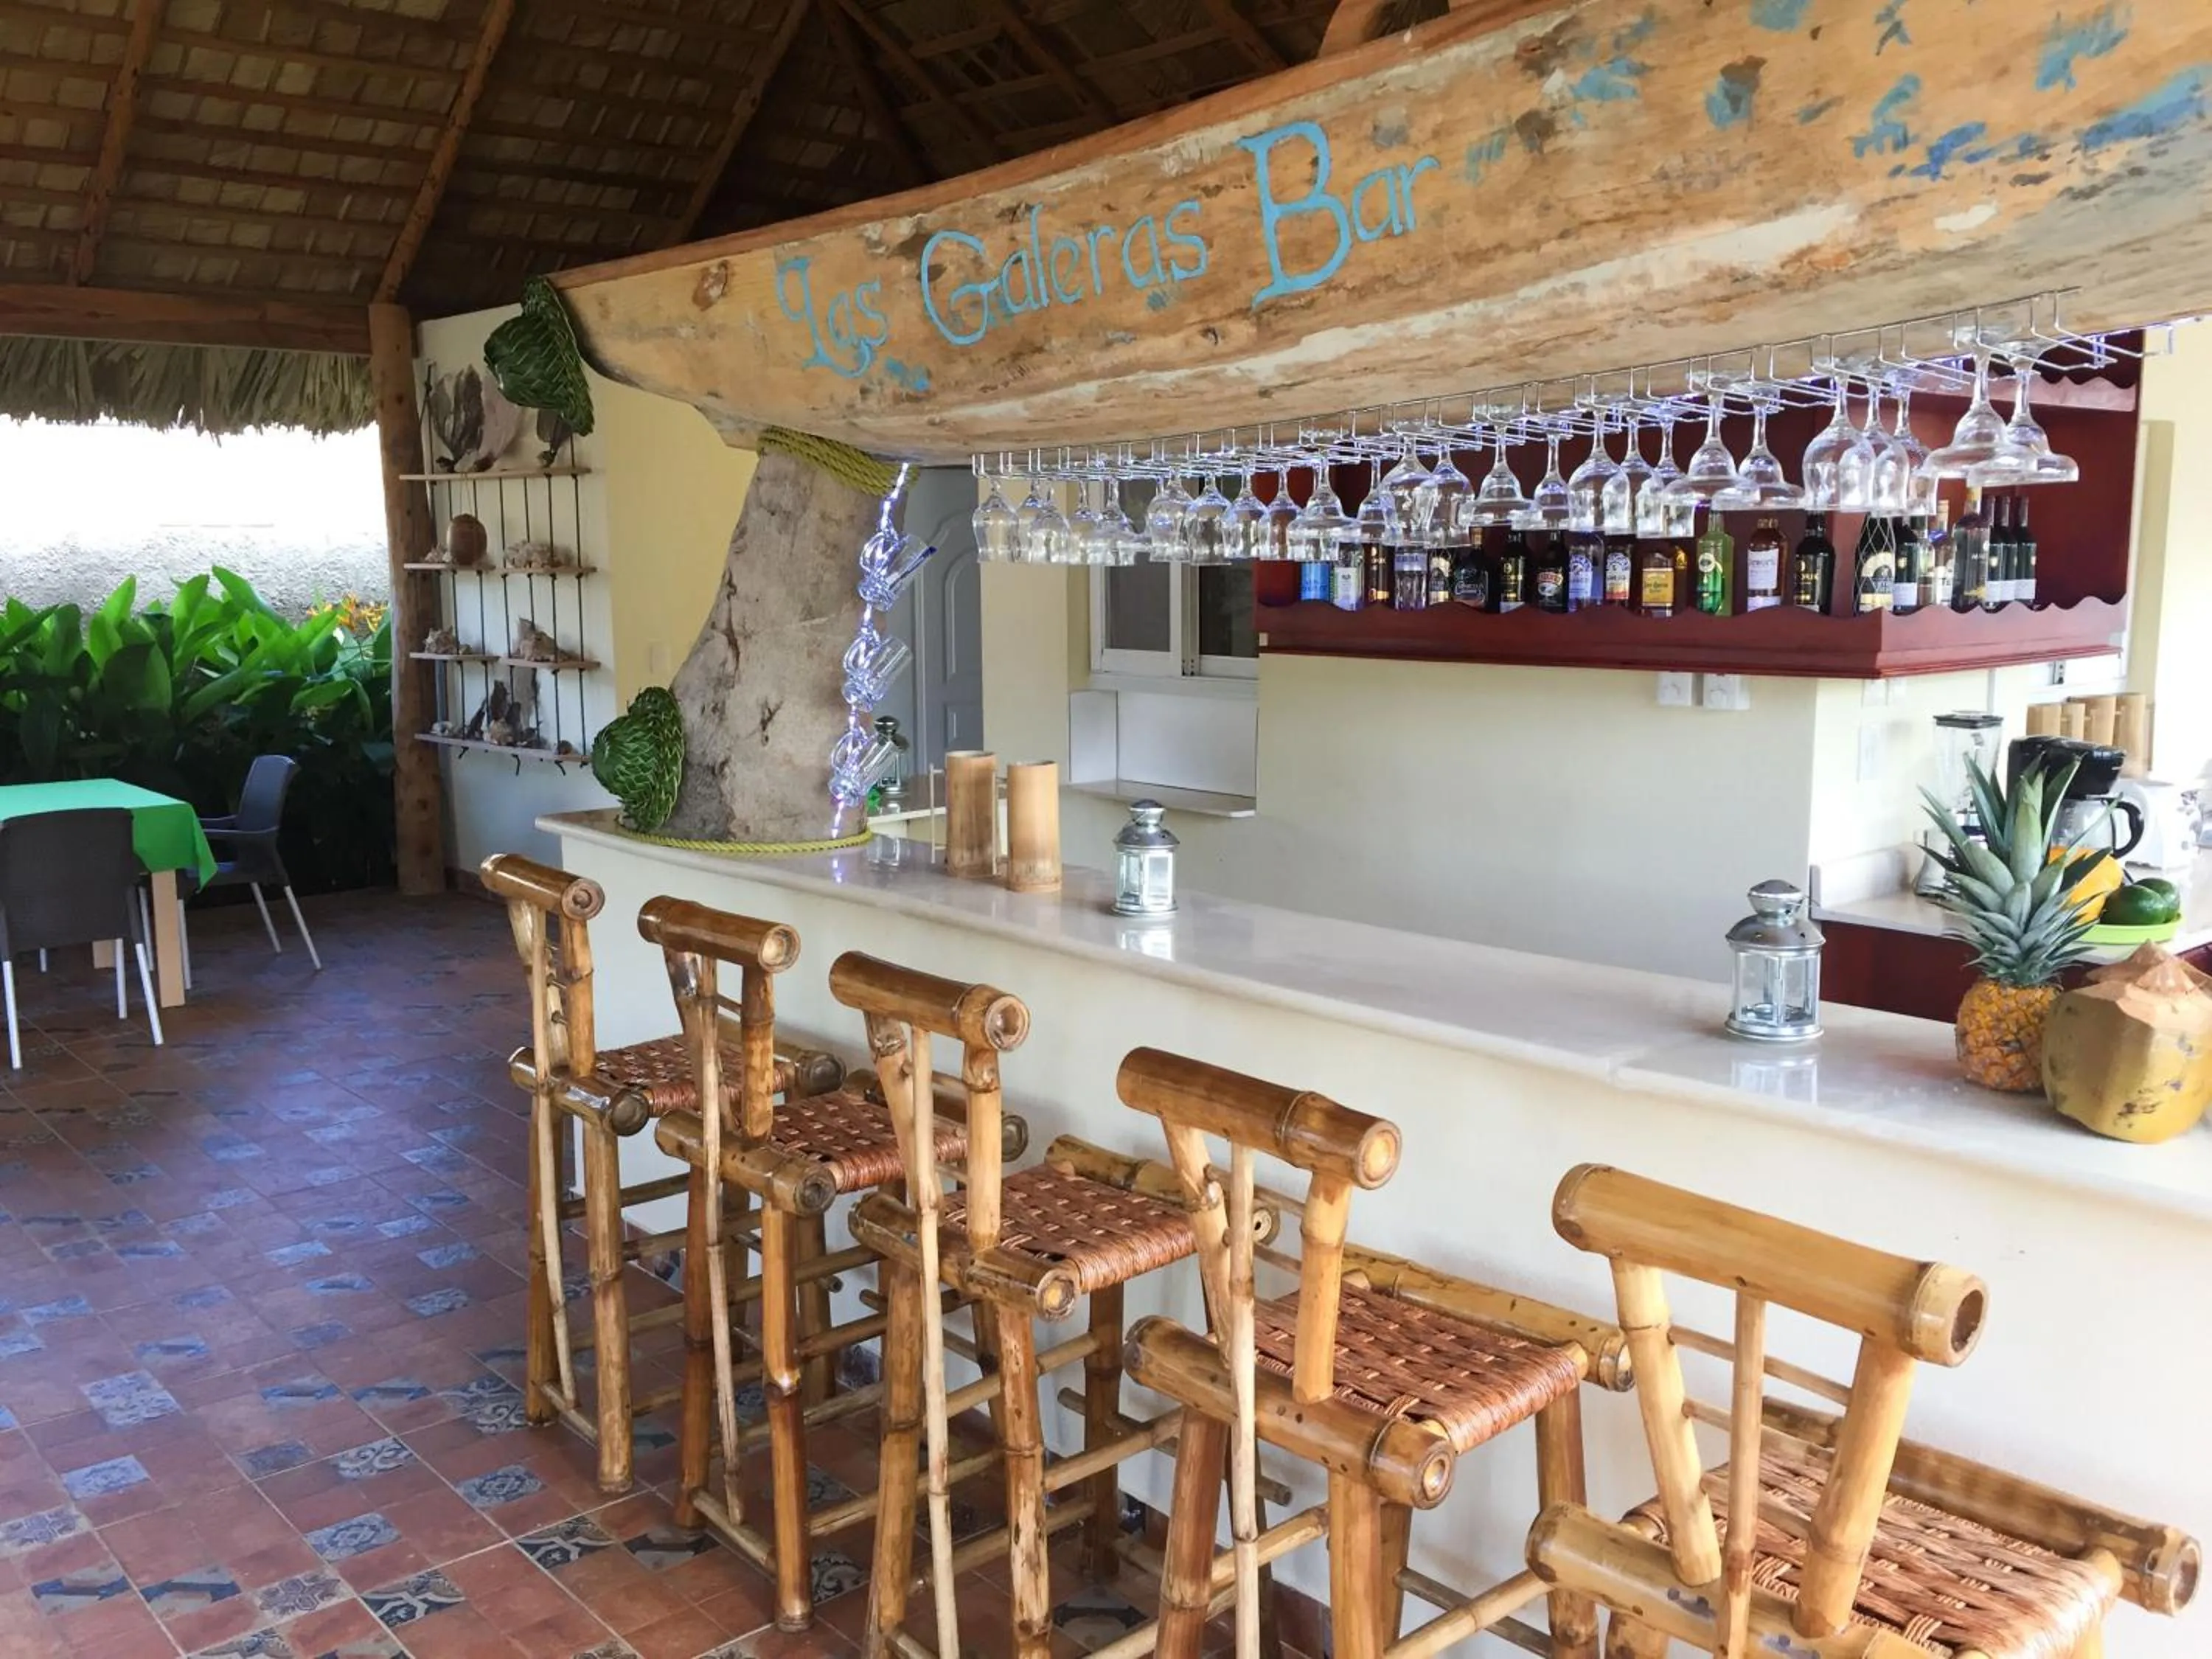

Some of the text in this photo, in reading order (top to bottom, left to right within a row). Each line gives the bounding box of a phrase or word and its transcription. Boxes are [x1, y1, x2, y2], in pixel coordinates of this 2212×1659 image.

[777, 120, 1441, 378] Las Galeras Bar
